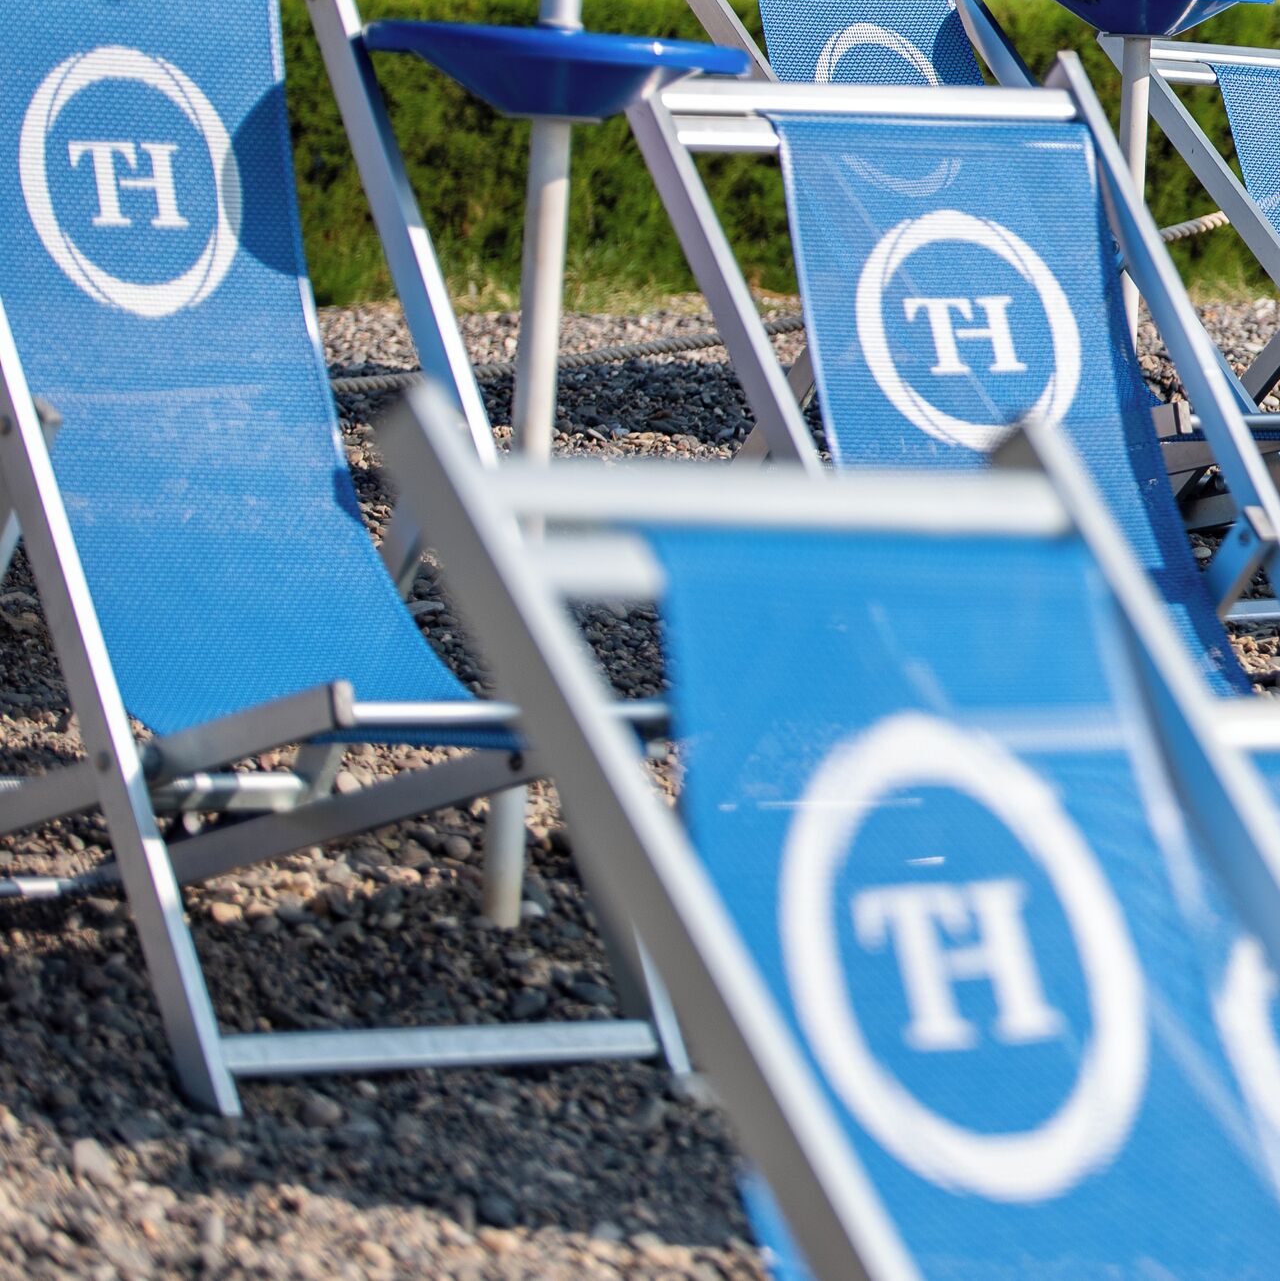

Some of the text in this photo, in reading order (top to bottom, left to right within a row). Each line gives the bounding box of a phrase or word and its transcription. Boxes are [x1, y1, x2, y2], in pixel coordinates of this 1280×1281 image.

[68, 140, 189, 228] TH
[904, 295, 1027, 375] TH
[850, 878, 1067, 1052] TH
